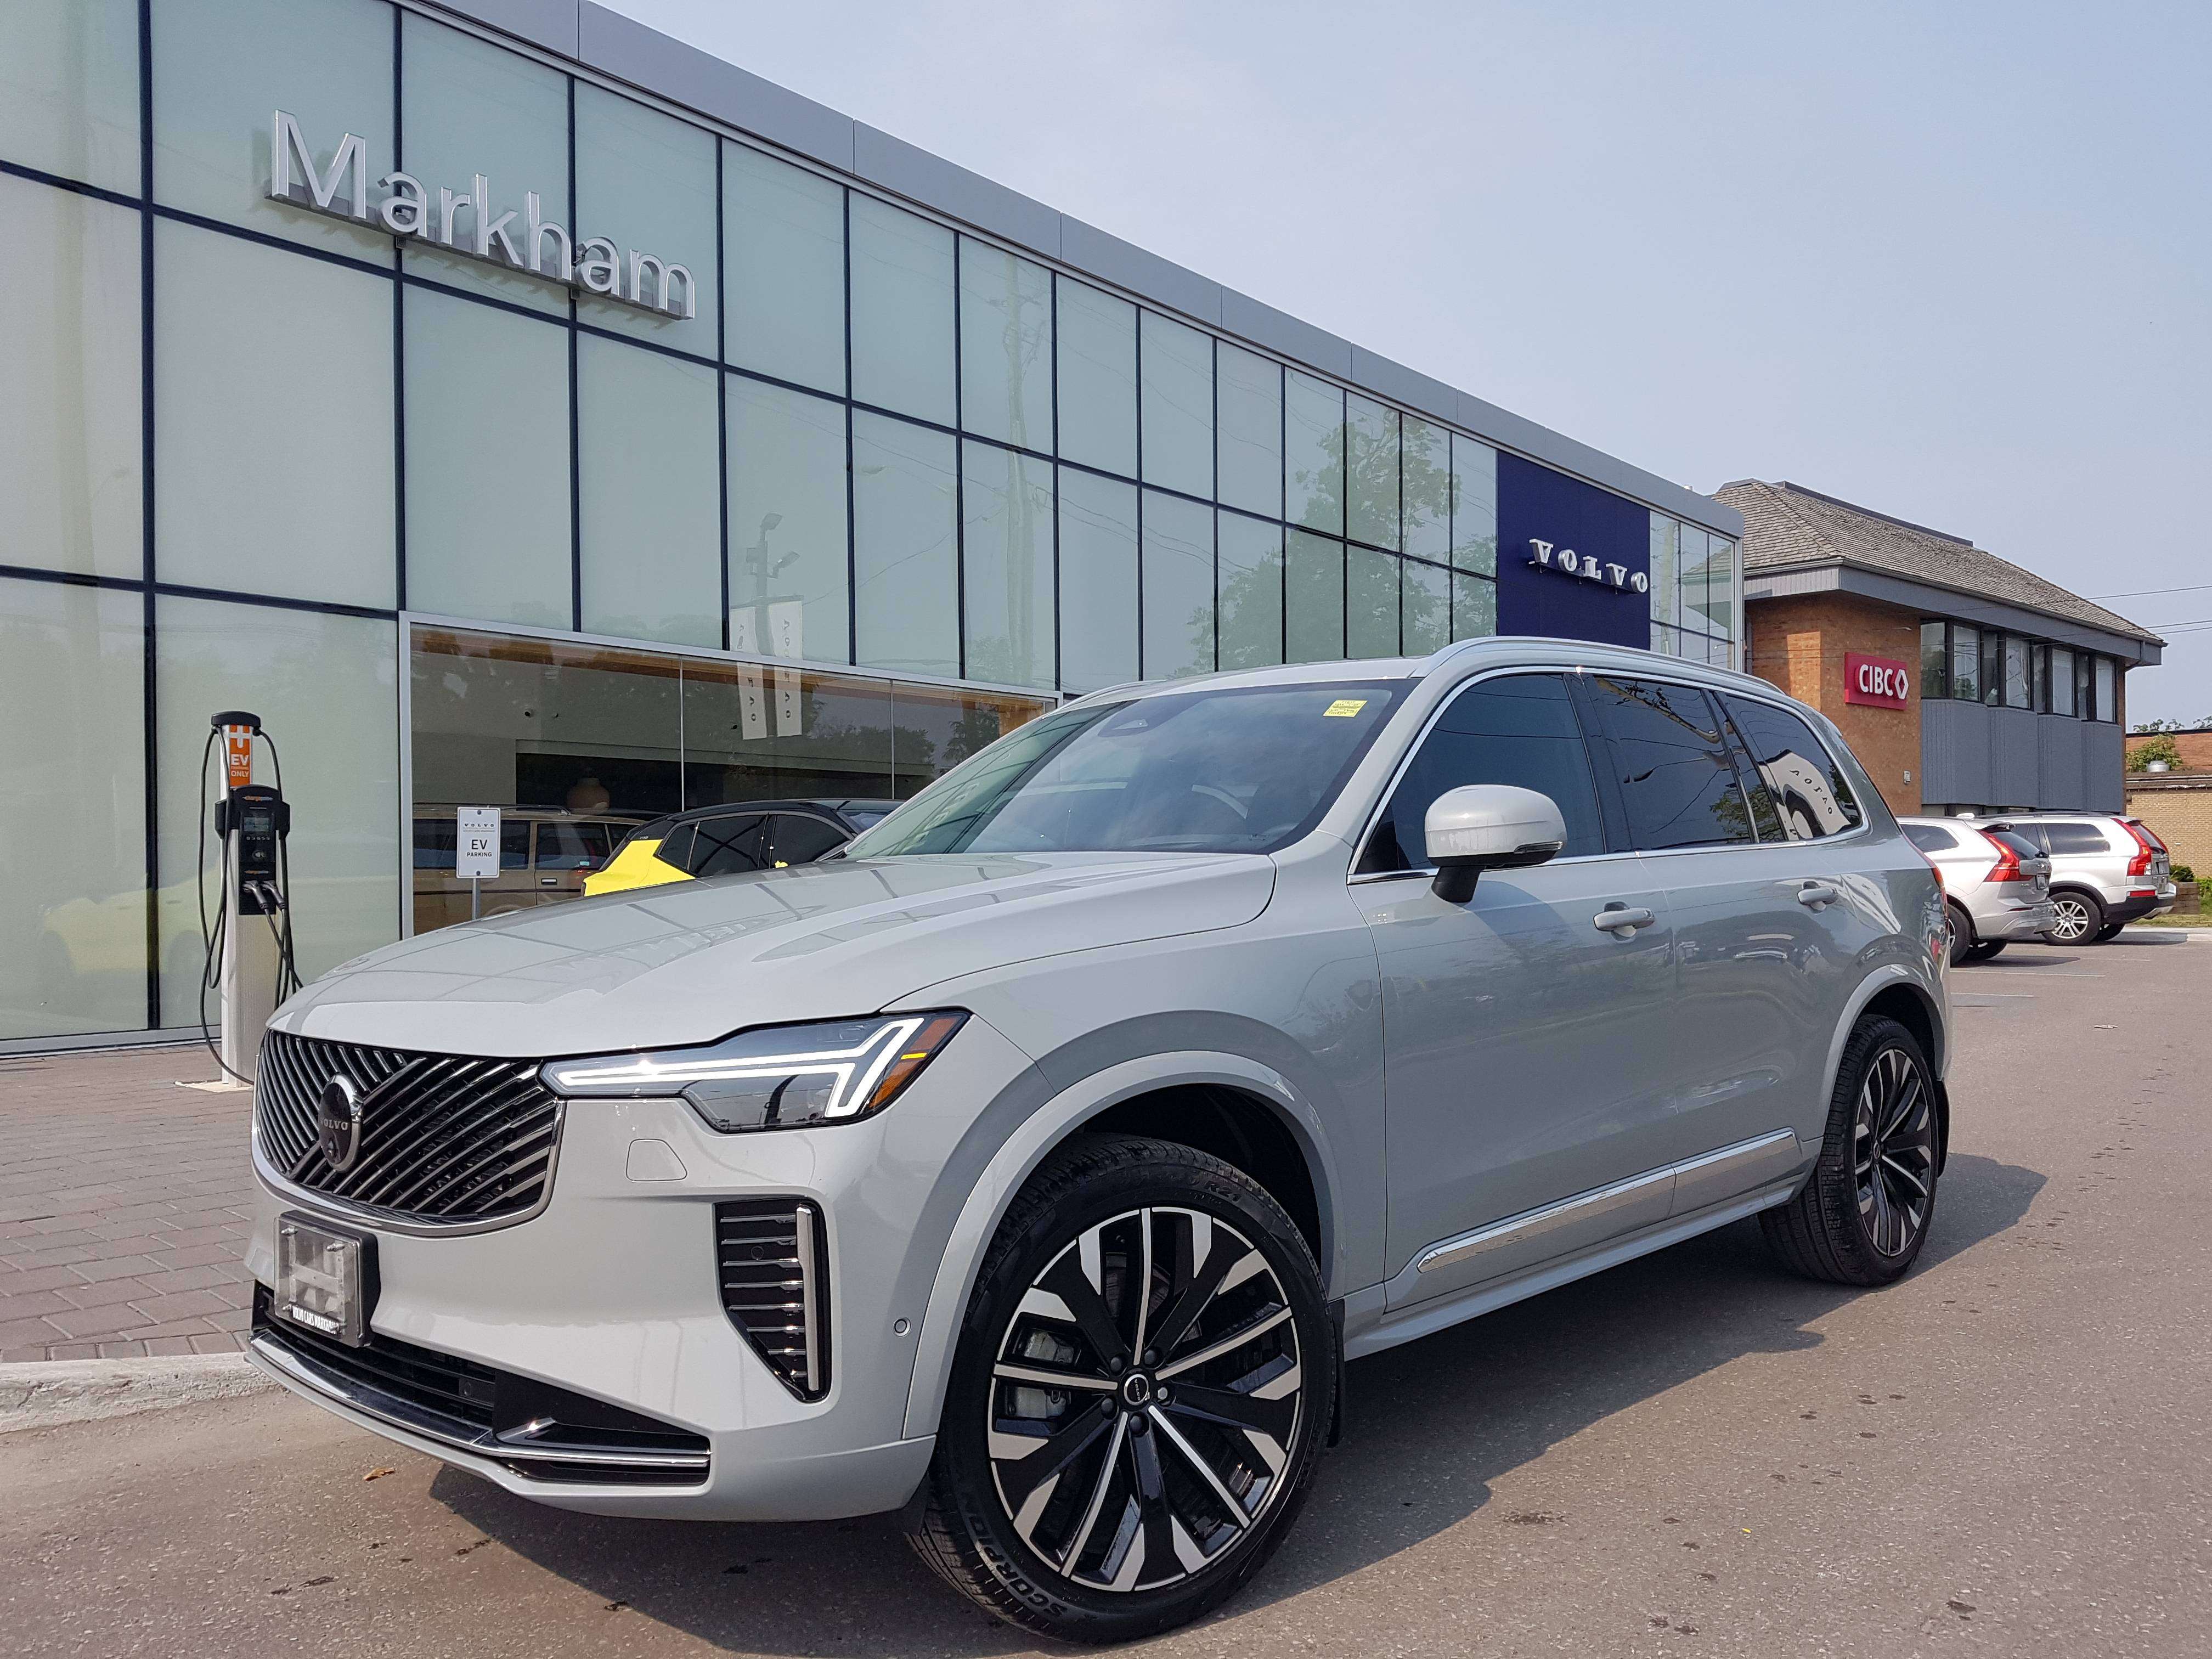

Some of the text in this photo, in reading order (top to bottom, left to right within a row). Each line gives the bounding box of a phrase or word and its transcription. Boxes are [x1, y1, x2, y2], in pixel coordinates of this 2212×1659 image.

[271, 109, 696, 319] Markham
[1529, 538, 1648, 593] VOLVO
[1859, 664, 1893, 696] CIBC
[231, 754, 249, 766] EV
[471, 839, 488, 850] EV
[314, 1315, 336, 1335] MARKHA
